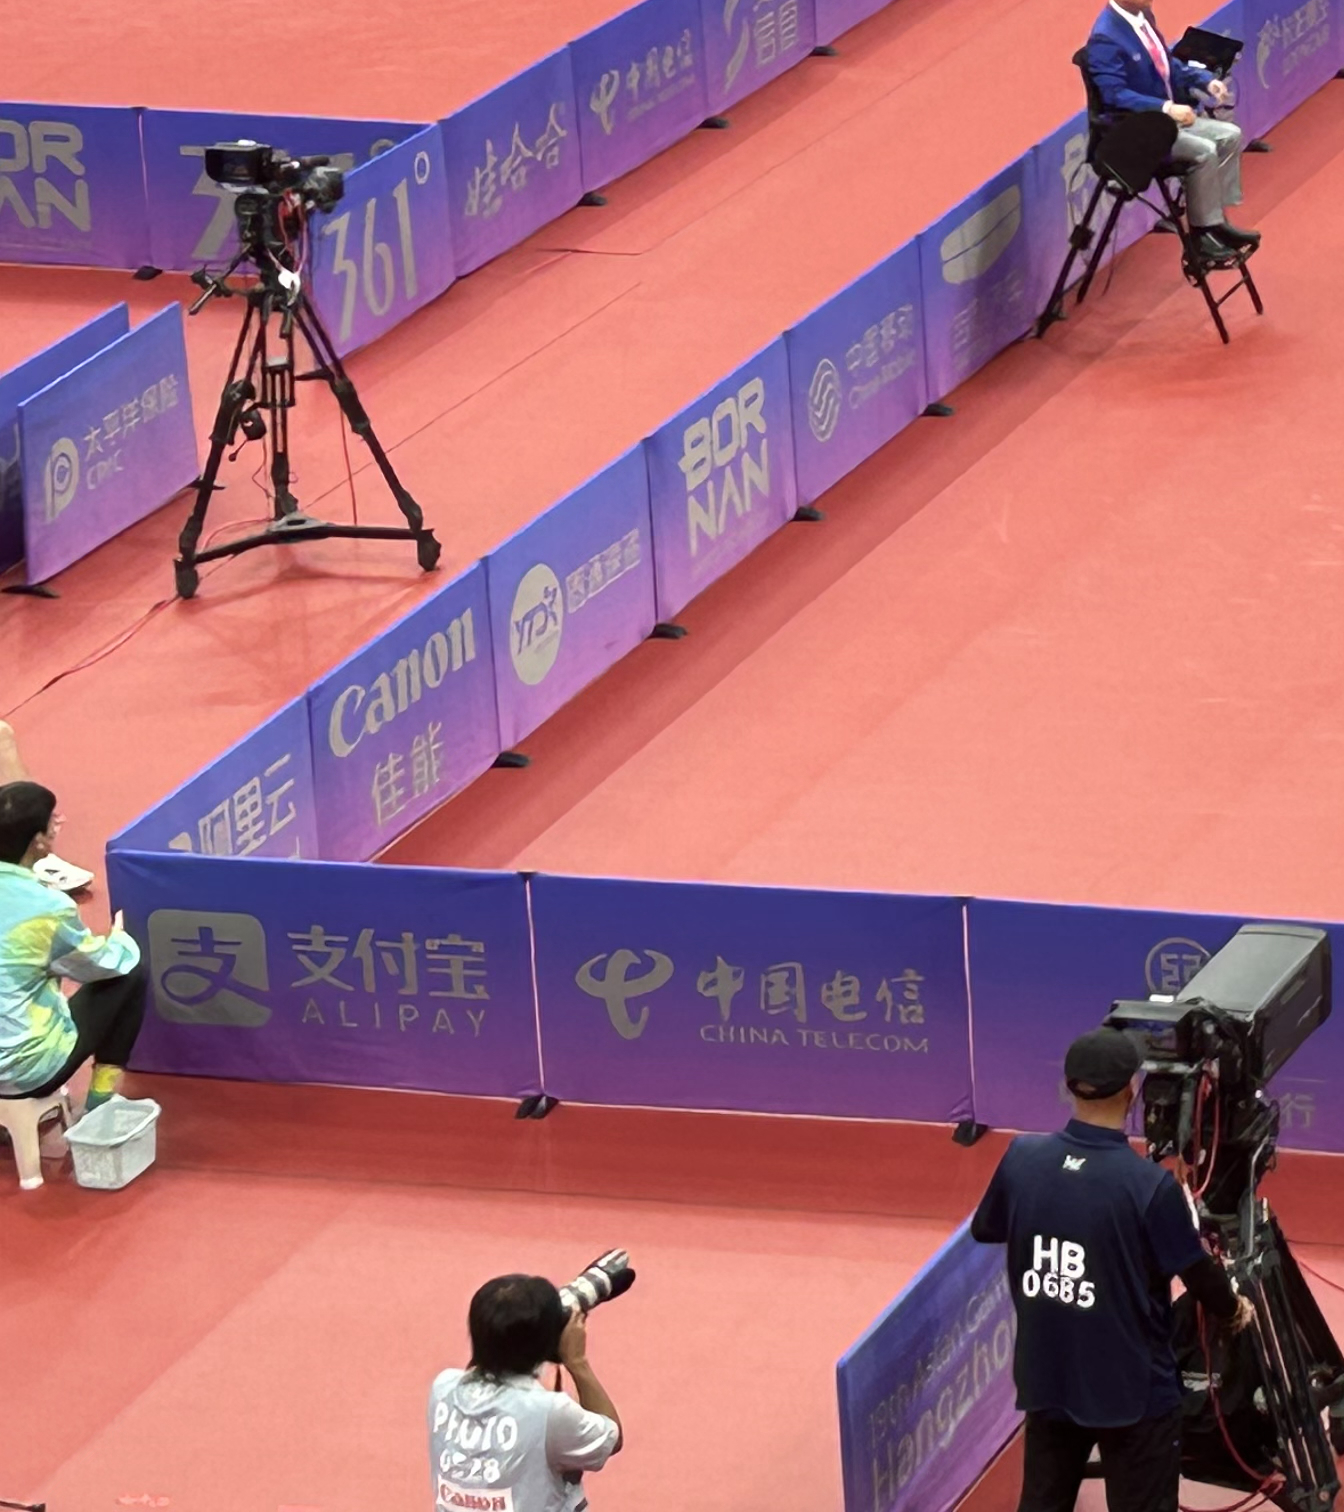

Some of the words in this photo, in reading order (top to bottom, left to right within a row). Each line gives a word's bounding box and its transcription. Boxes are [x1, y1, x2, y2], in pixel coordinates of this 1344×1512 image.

[677, 376, 768, 492] BOR
[686, 438, 771, 558] NAN
[328, 607, 476, 758] Canon
[371, 721, 447, 827] 佳能
[286, 924, 491, 1001] 支付宝
[696, 955, 926, 1025] 中国电信
[301, 998, 487, 1038] ALIPAY
[699, 1023, 790, 1047] CHINA
[797, 1028, 929, 1054] TELECOM
[1021, 1267, 1097, 1310] 0685
[1032, 1234, 1087, 1280] HB
